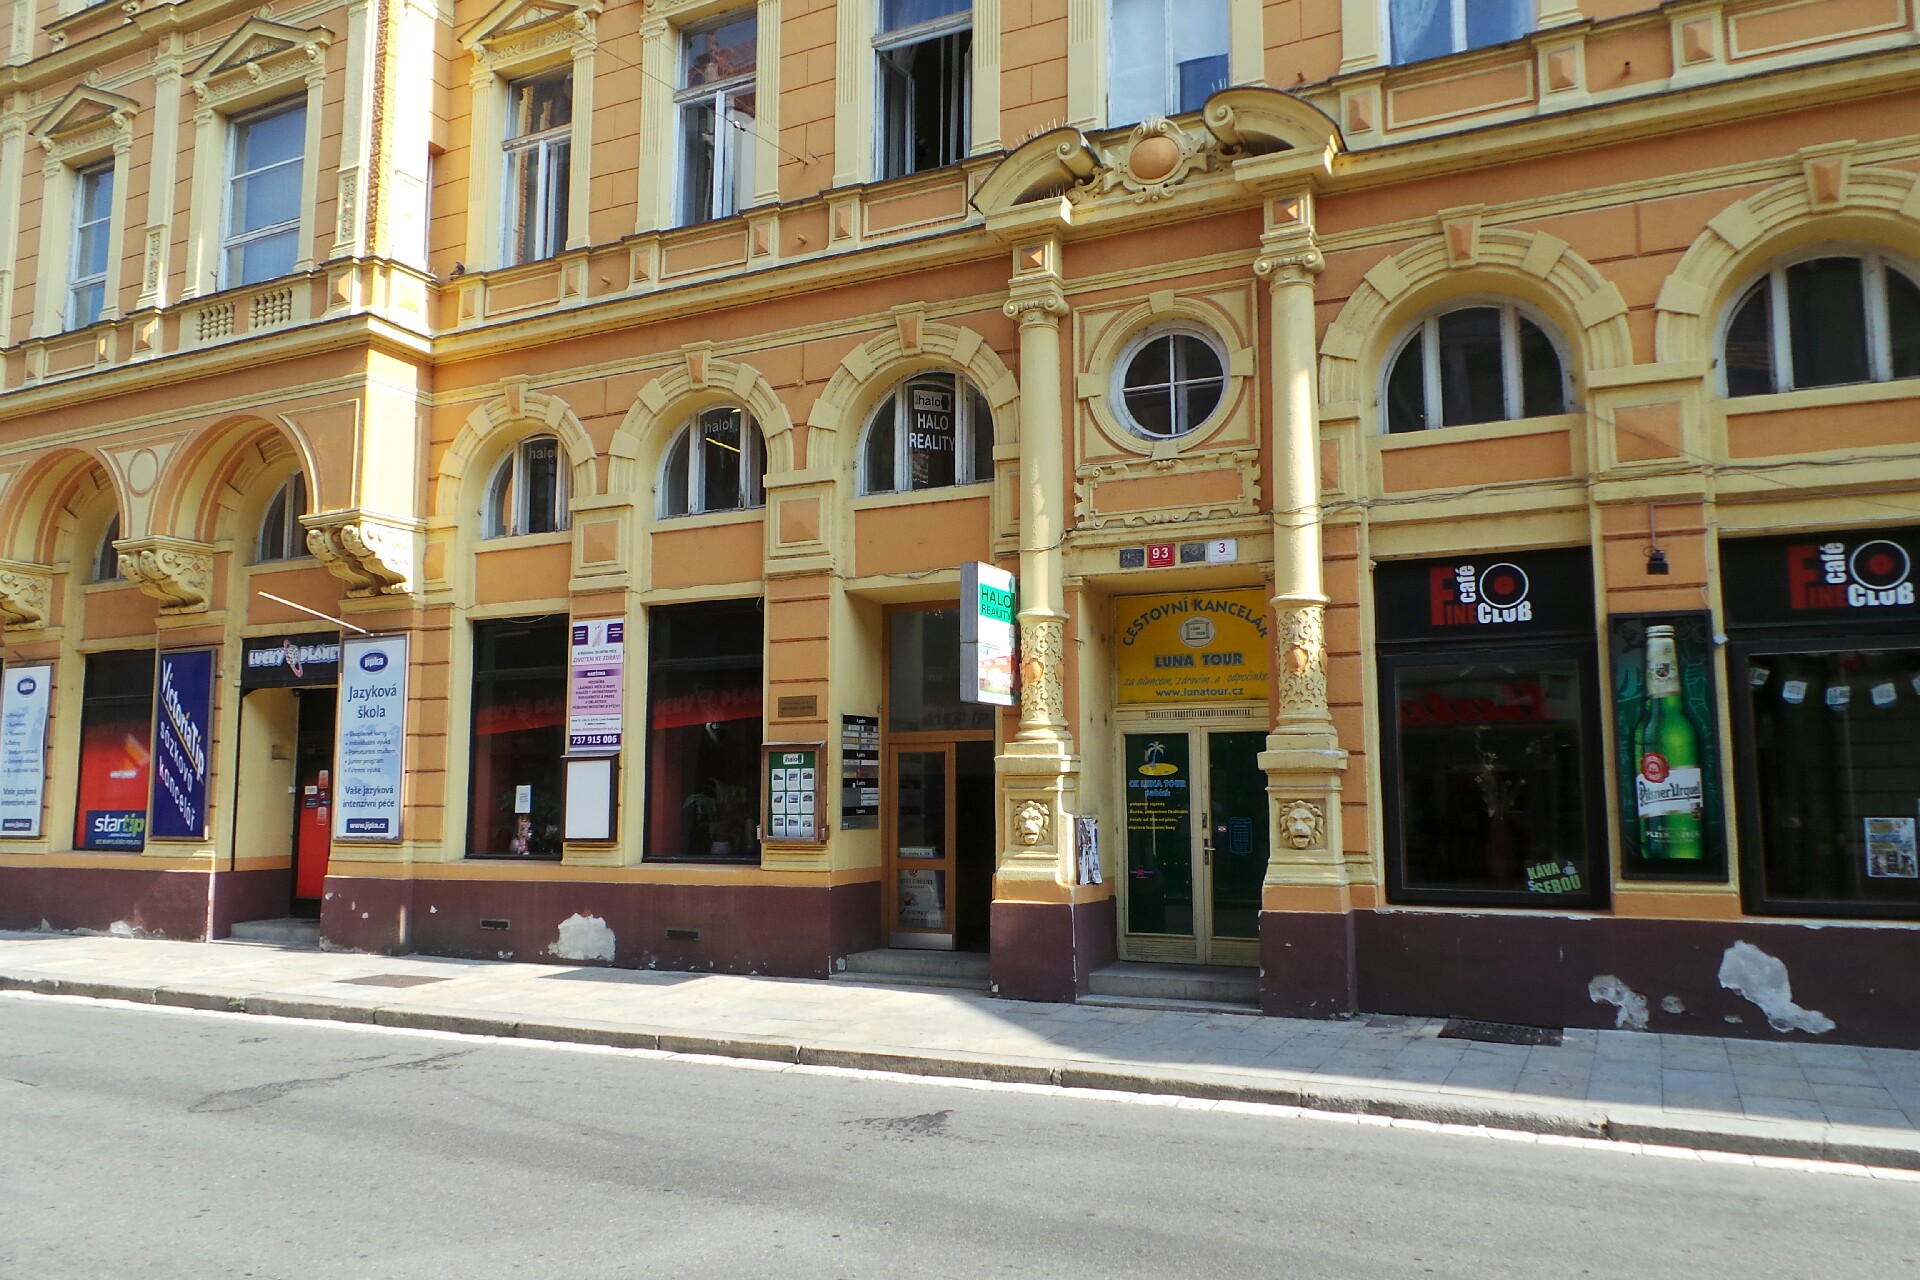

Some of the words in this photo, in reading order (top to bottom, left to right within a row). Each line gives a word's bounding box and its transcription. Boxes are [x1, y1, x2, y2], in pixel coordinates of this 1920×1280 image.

[919, 395, 940, 407] halo
[917, 412, 949, 430] HALO
[909, 432, 955, 451] REALITY
[1152, 547, 1169, 559] 93
[1218, 542, 1226, 553] 3
[1818, 542, 1847, 584] café
[1455, 565, 1477, 603] café
[981, 586, 1012, 609] HALO
[1847, 581, 1916, 608] CLUB
[981, 603, 1012, 620] REALITY
[1477, 600, 1533, 624] CLUB
[1122, 597, 1188, 647] CESTOVNÍ
[248, 646, 285, 668] LUCKY
[300, 643, 340, 664] PLANET
[1154, 653, 1195, 669] LUNA
[1202, 652, 1244, 668] TOUR
[1227, 671, 1269, 684] odpočinke
[347, 683, 397, 702] Jazyková
[1155, 687, 1244, 698] www.lunatour.cz
[161, 659, 205, 781] VictoriaTip
[357, 704, 386, 719] škola
[572, 736, 586, 745] 737
[587, 735, 602, 744] 915
[602, 735, 617, 744] 006
[159, 721, 193, 793] sázková
[159, 755, 196, 831] kancelář
[345, 785, 361, 795] Vaše
[362, 785, 394, 797] jazyková
[1140, 780, 1162, 788] LUNA
[1164, 780, 1187, 788] TOUR
[377, 800, 395, 809] péče
[93, 813, 145, 838] startip
[1526, 862, 1561, 880] KÁVA
[1534, 874, 1581, 894] SEBOU
